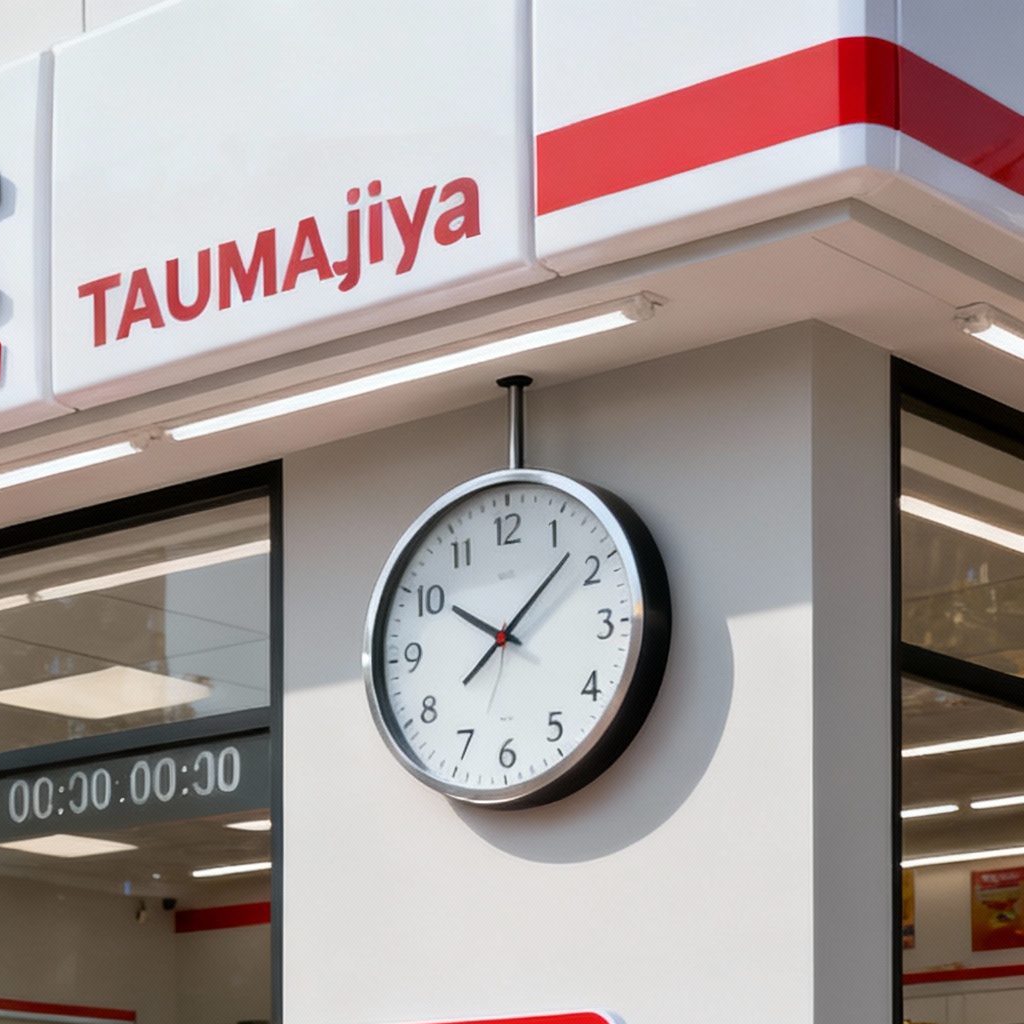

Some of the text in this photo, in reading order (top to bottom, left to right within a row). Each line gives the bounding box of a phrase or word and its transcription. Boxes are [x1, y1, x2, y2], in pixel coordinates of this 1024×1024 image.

[493, 513, 522, 546] 12
[548, 519, 558, 548] 1
[450, 538, 471, 569] 11
[582, 555, 602, 587] 2
[417, 584, 446, 617] 10
[596, 608, 615, 641] 3
[403, 642, 423, 674] 9
[580, 670, 603, 702] 4
[419, 695, 438, 725] 8
[546, 711, 564, 743] 5
[456, 728, 475, 761] 7
[498, 738, 518, 769] 6
